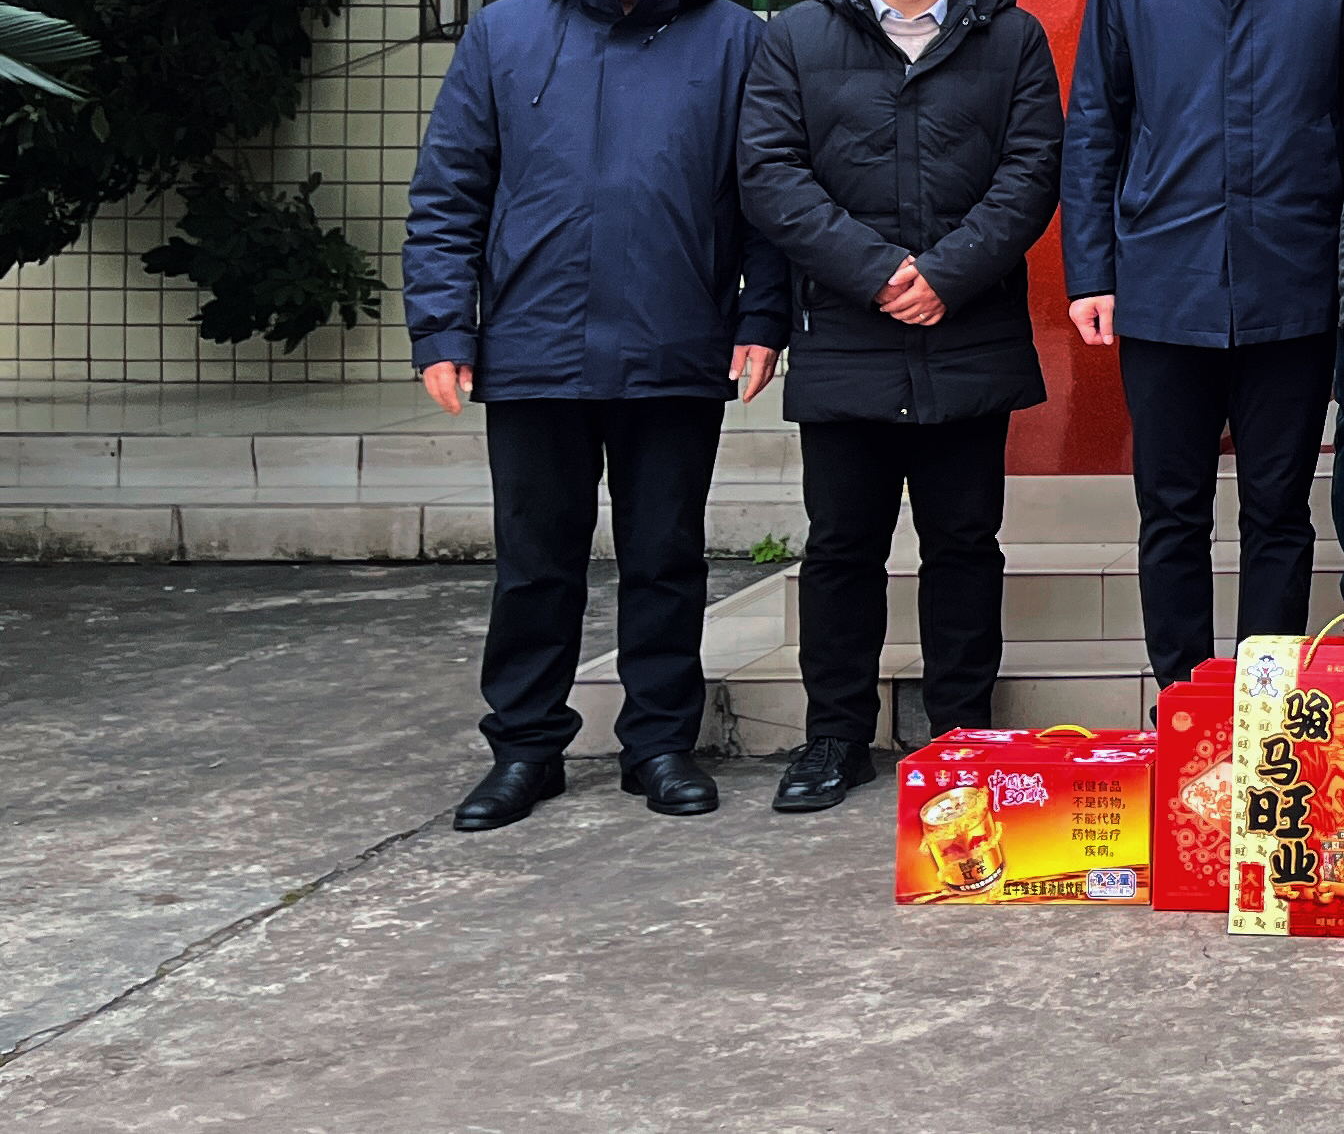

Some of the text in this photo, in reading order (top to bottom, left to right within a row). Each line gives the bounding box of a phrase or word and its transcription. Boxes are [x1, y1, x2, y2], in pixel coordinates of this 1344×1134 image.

[1073, 780, 1121, 792] 保健食品
[1248, 691, 1332, 884] 骏马旺业
[1072, 813, 1120, 825] 不能代替
[1072, 829, 1120, 841] 药物治疗
